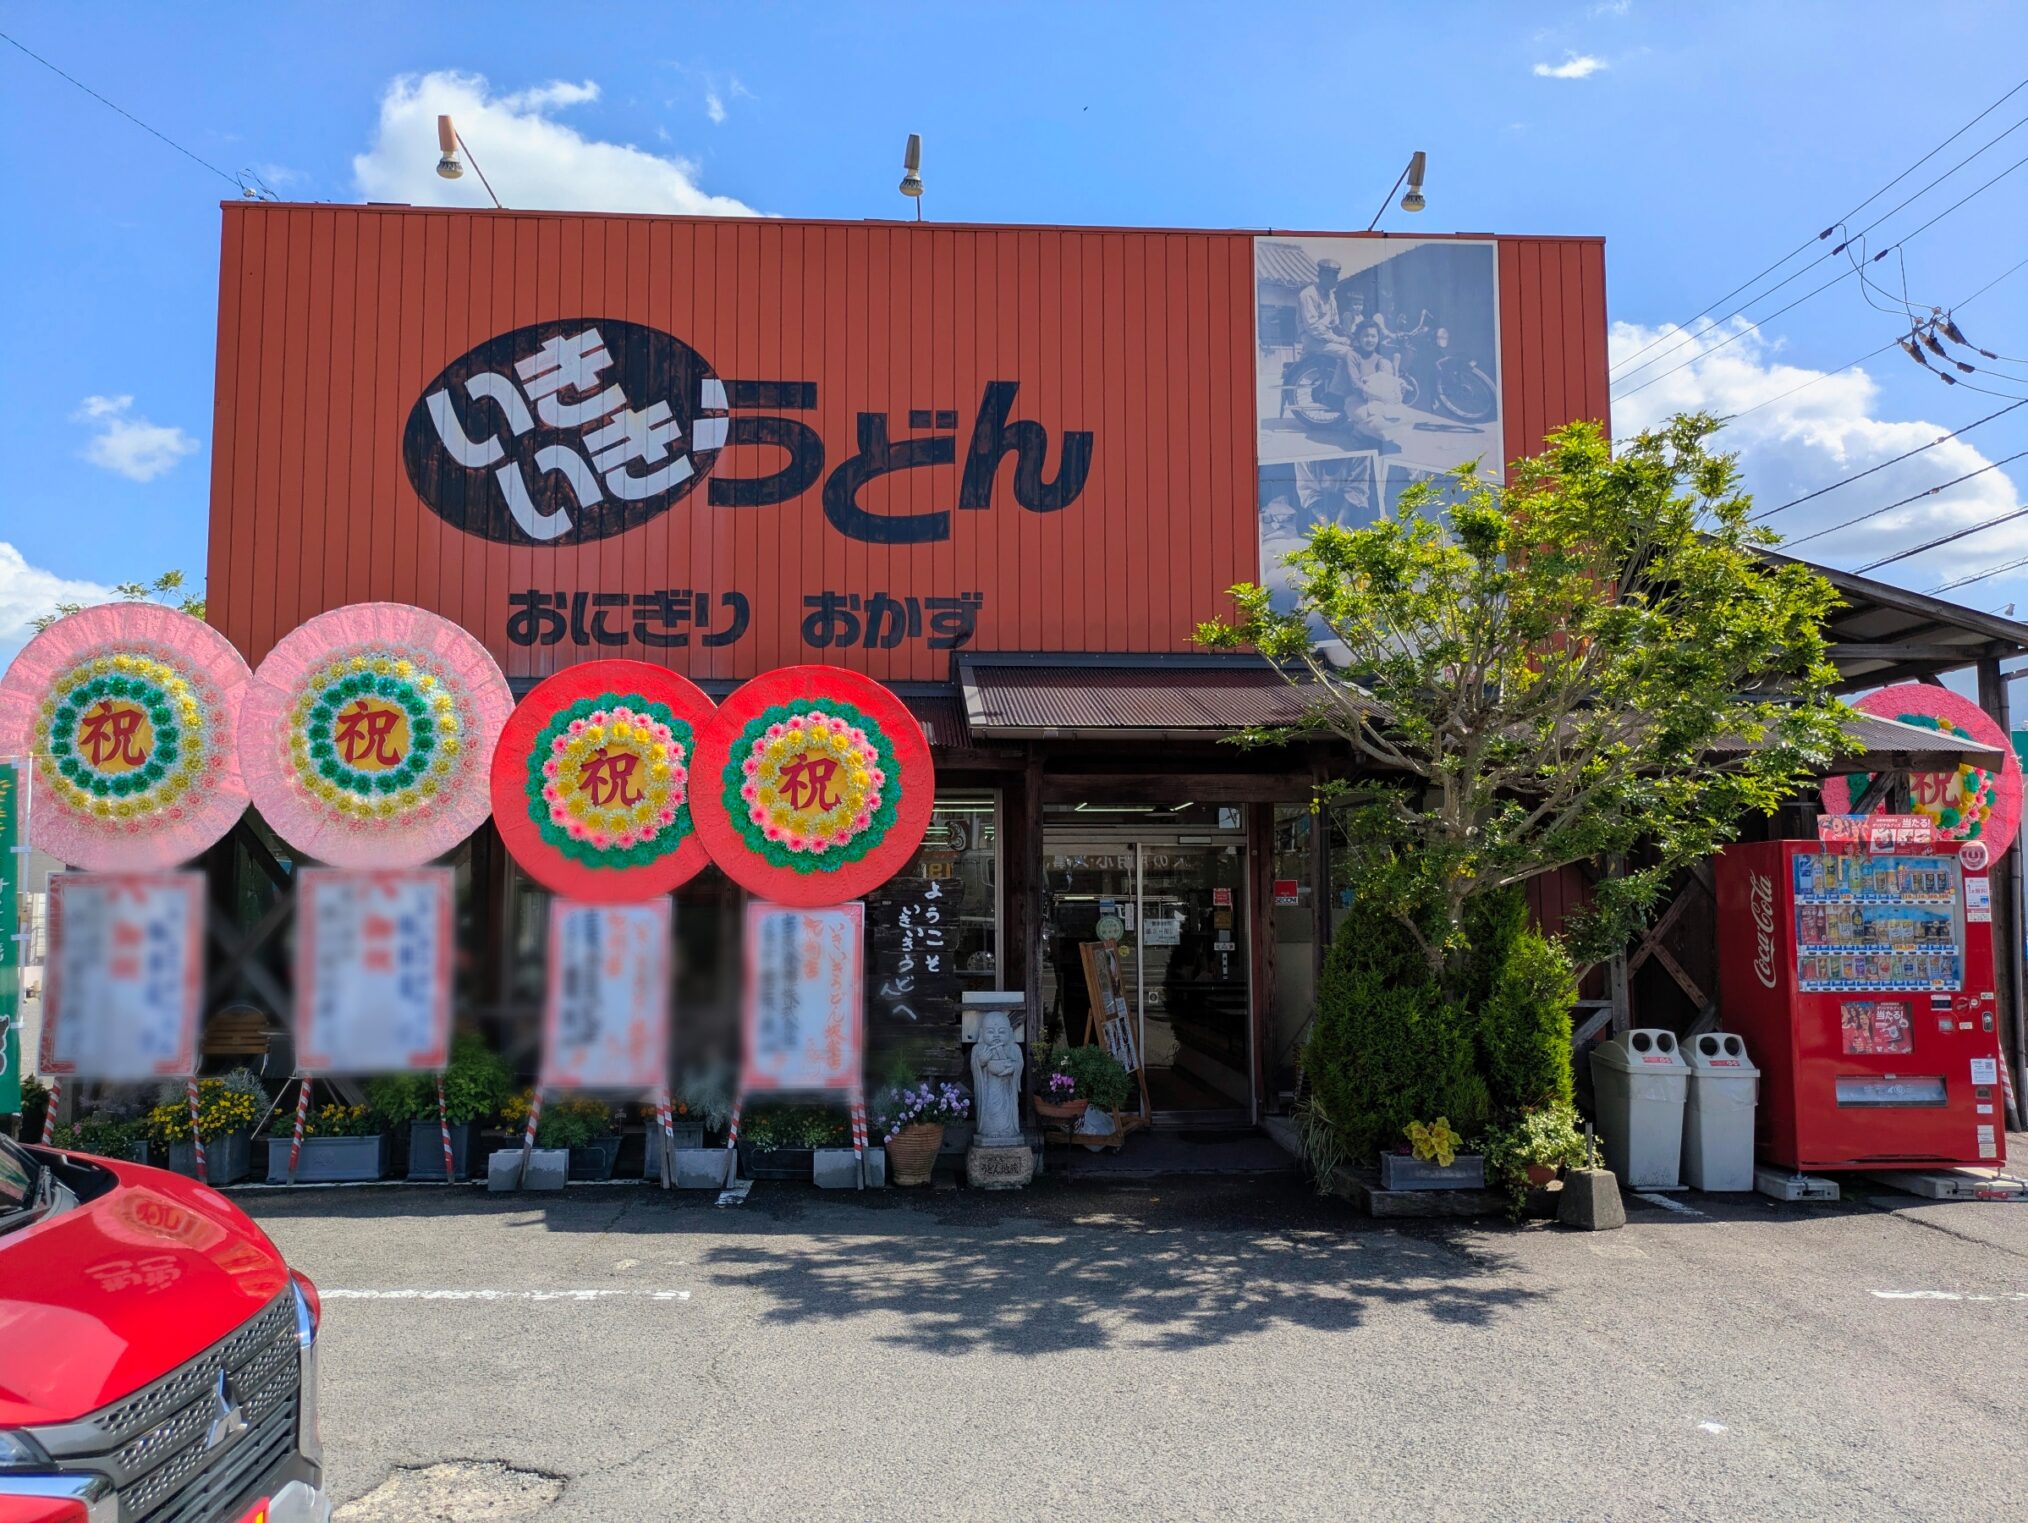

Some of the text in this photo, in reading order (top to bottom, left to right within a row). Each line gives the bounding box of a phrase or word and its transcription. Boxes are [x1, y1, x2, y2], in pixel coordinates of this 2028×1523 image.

[506, 589, 984, 649] おにぎり おかず
[80, 701, 147, 766] 祝
[335, 700, 401, 766] 祝
[579, 748, 645, 807] 祝
[779, 753, 842, 811] 祝
[924, 881, 944, 972] ようこそ
